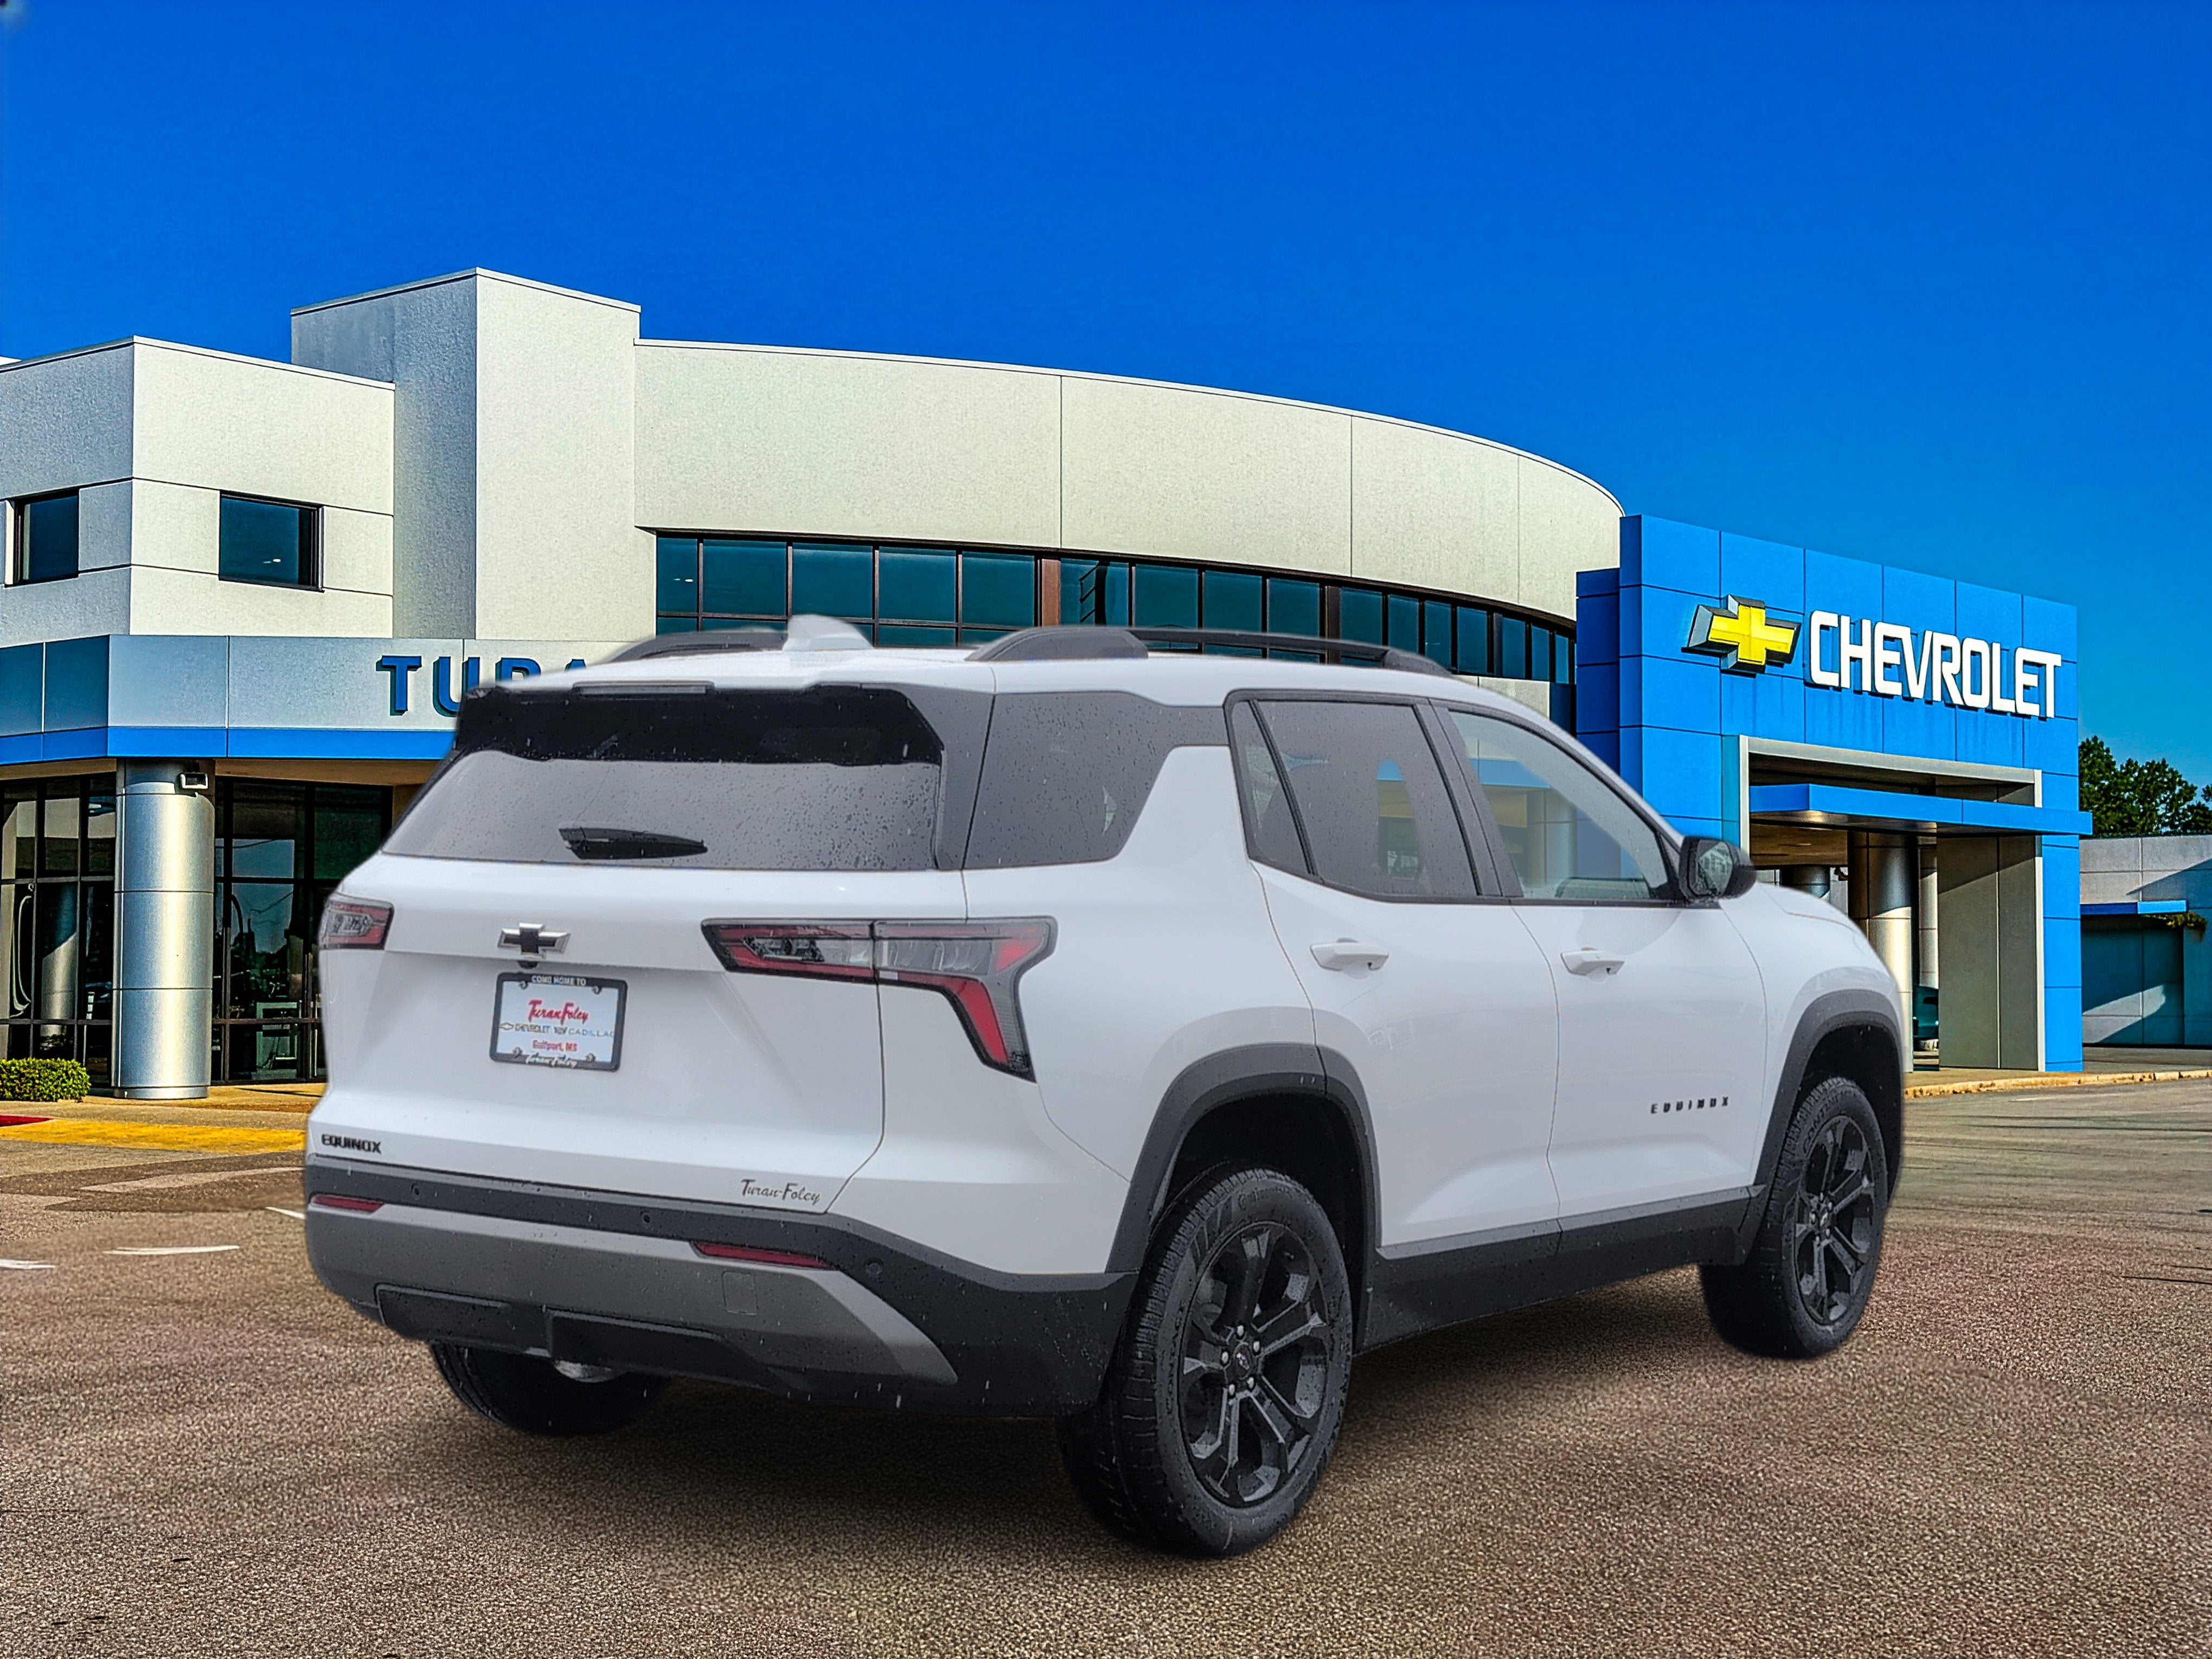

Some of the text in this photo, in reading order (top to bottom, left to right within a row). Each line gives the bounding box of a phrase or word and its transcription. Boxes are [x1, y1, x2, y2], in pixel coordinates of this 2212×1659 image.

[1809, 610, 2062, 719] CHEVROLET
[376, 655, 587, 717] TU
[576, 978, 587, 987] TO
[565, 1041, 577, 1052] MS
[1650, 1096, 1729, 1114] EQUINOX
[321, 1134, 382, 1154] EQUINOX
